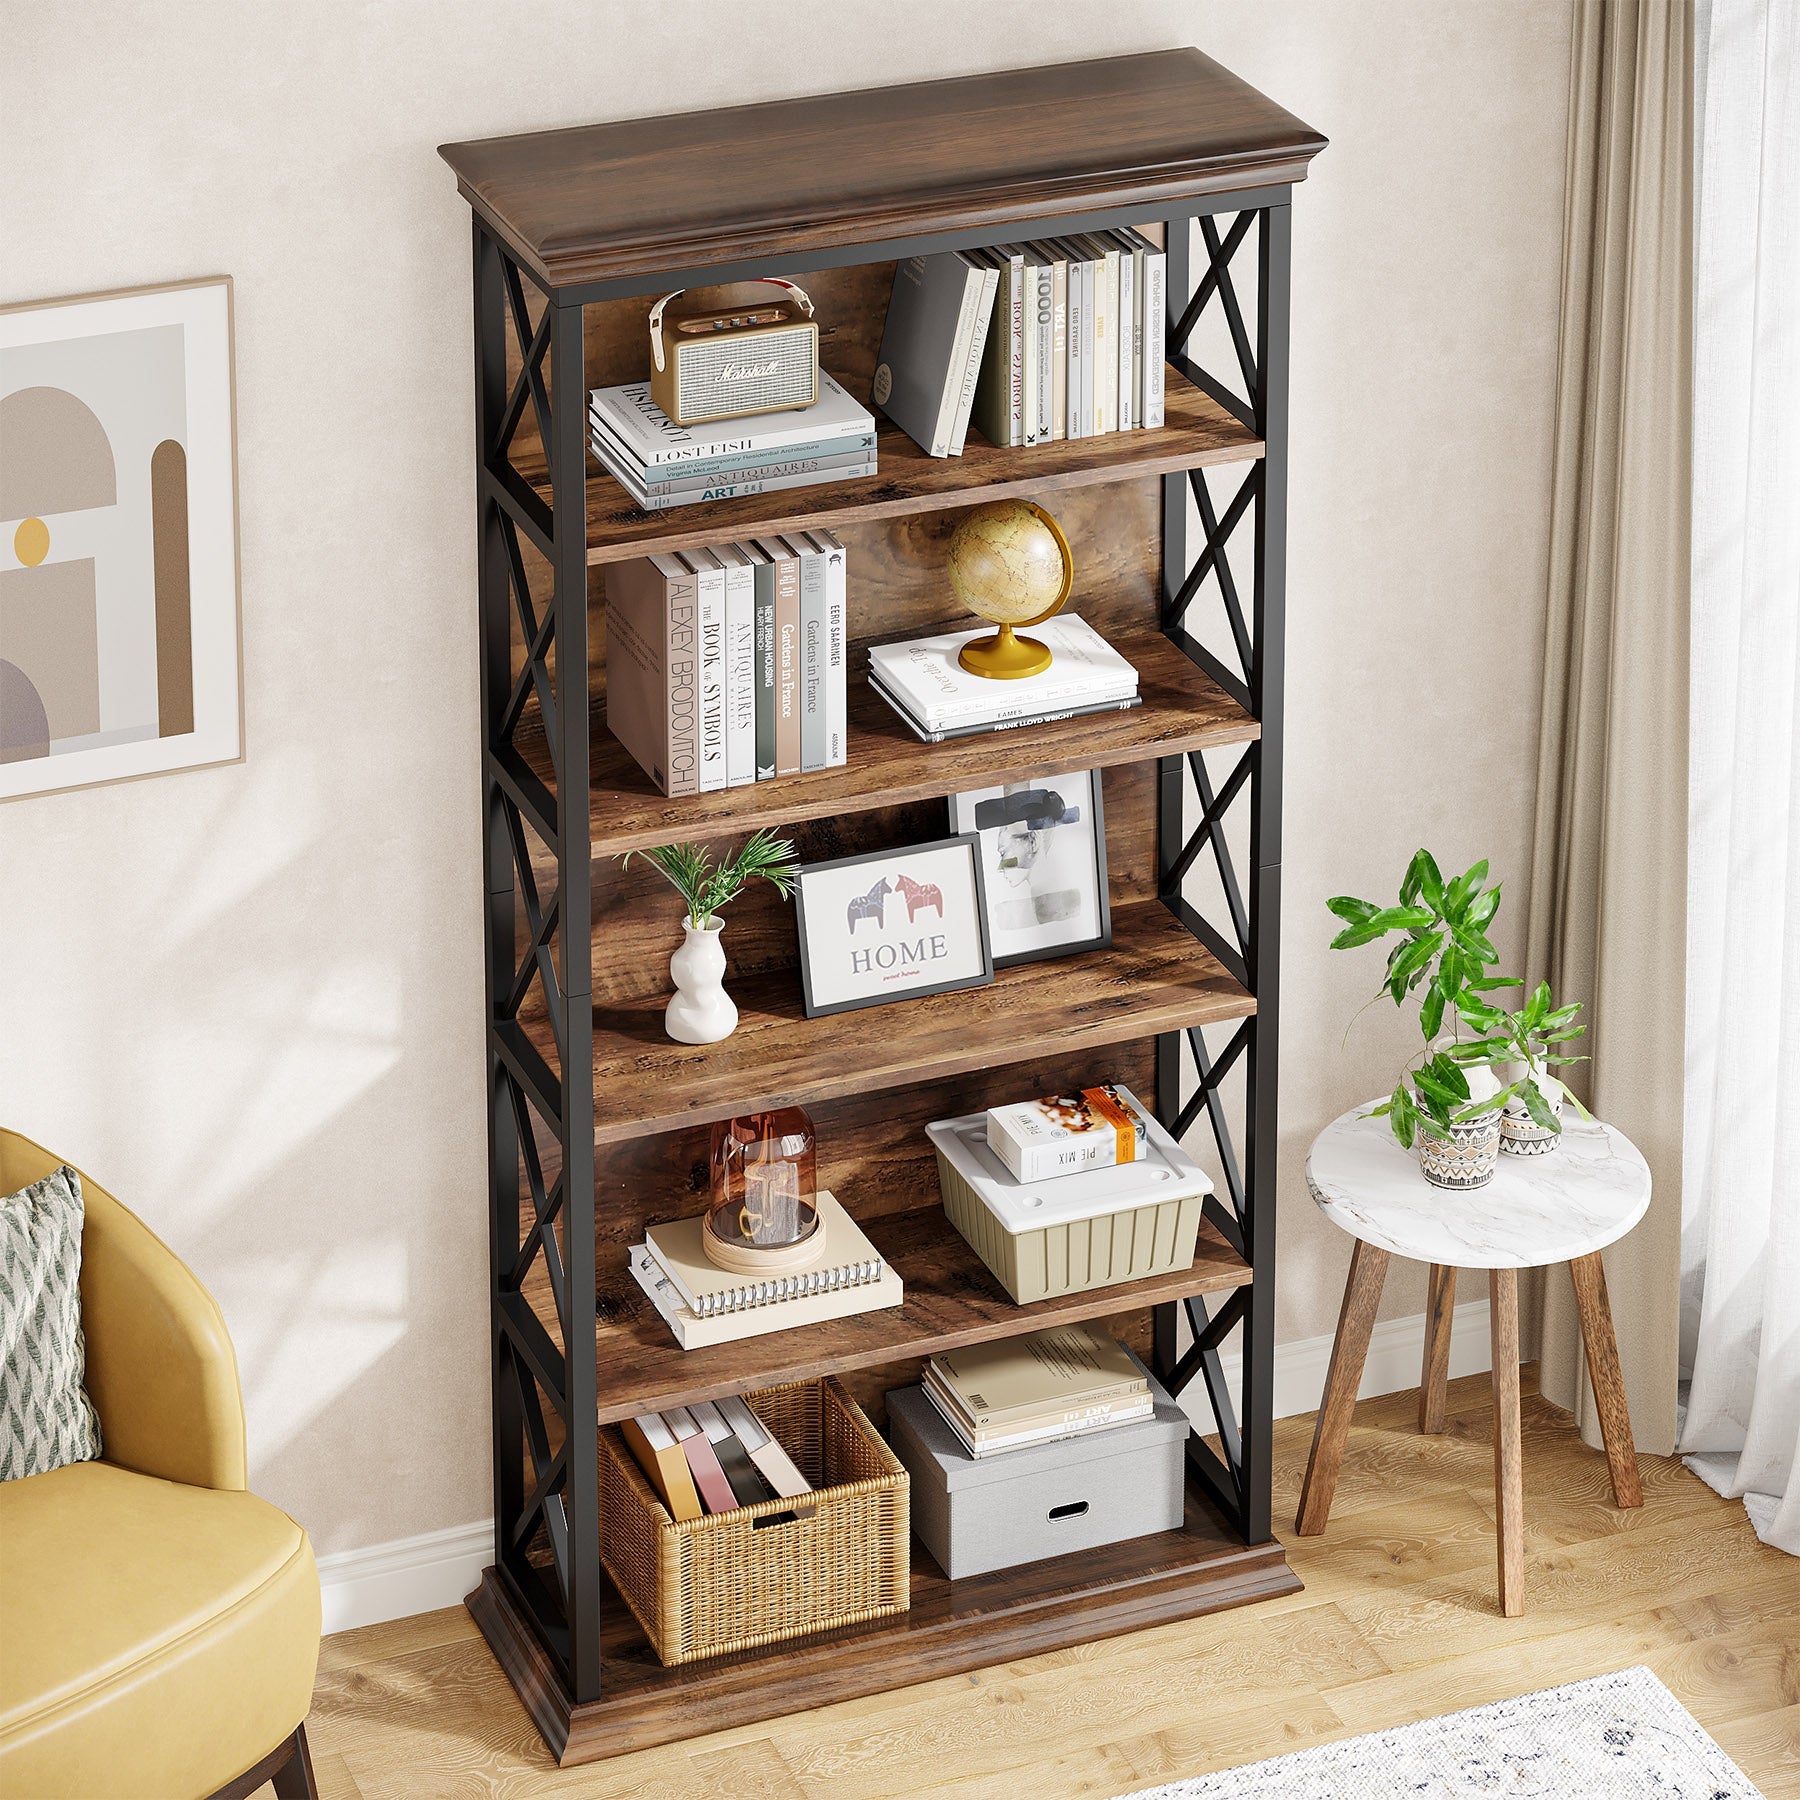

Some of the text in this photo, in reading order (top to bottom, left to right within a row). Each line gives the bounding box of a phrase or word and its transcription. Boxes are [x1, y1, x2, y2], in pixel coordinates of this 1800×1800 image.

[714, 360, 779, 382] Marshall
[622, 388, 661, 413] FISH
[646, 415, 692, 442] LOST
[656, 440, 752, 462] LOST FISH
[666, 464, 685, 472] Detail
[694, 456, 740, 468] Contemporary
[743, 450, 779, 460] Residential
[780, 444, 820, 454] Architecture
[666, 465, 720, 478] Virginia McLeod
[706, 460, 818, 483] ANTIQUAIRES
[701, 486, 738, 500] ART
[757, 606, 765, 626] HILARY
[765, 605, 774, 688] NEW URBAN HOUSING
[830, 605, 840, 666] EERO SAARINEN
[807, 620, 819, 714] Gardens in France
[909, 648, 928, 663] Top
[734, 622, 752, 729] ANTIQUAIRES
[782, 624, 795, 718] Gardens in France
[670, 583, 694, 784] ALEXEY BRODOVITCH
[703, 605, 721, 761] THE BOOK OF SYMBOLS
[994, 712, 1074, 731] FRANK LLOYD WRIGHT
[998, 709, 1022, 718] EAMES
[851, 934, 948, 974] HOME
[1058, 1147, 1096, 1165] PIE MIX
[1084, 1404, 1112, 1417] ART
[1086, 1415, 1112, 1426] ART
